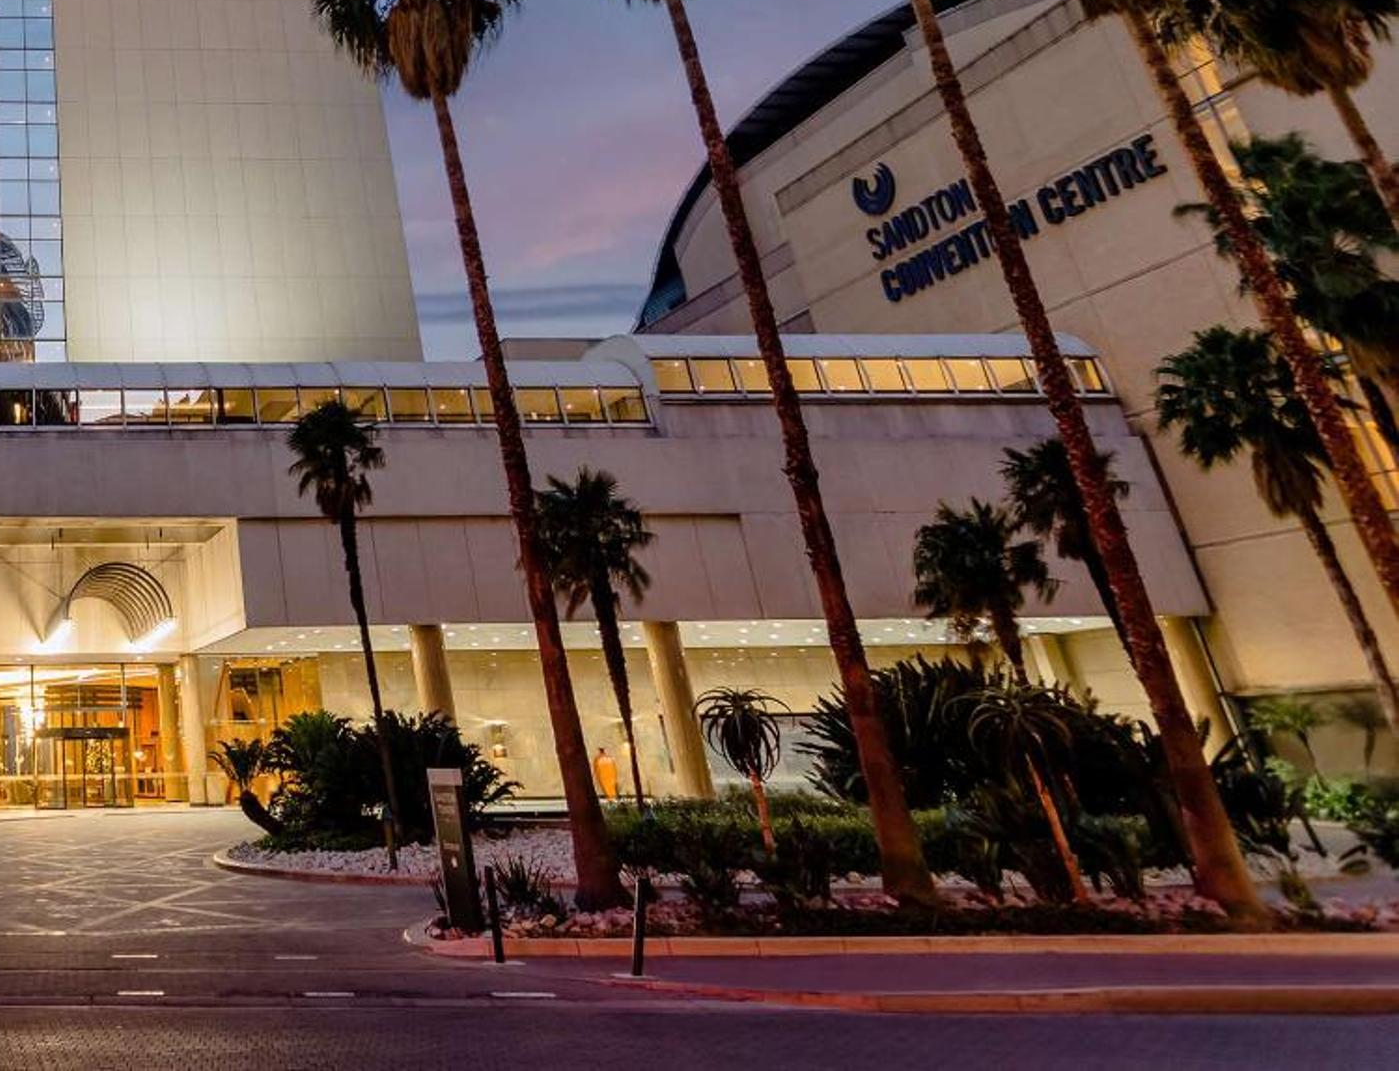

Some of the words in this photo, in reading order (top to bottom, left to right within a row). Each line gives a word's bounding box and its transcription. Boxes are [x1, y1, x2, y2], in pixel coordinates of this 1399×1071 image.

[866, 178, 977, 260] SANDTON
[880, 199, 1039, 302] CONVENTIN
[1037, 133, 1168, 225] CENTRE
